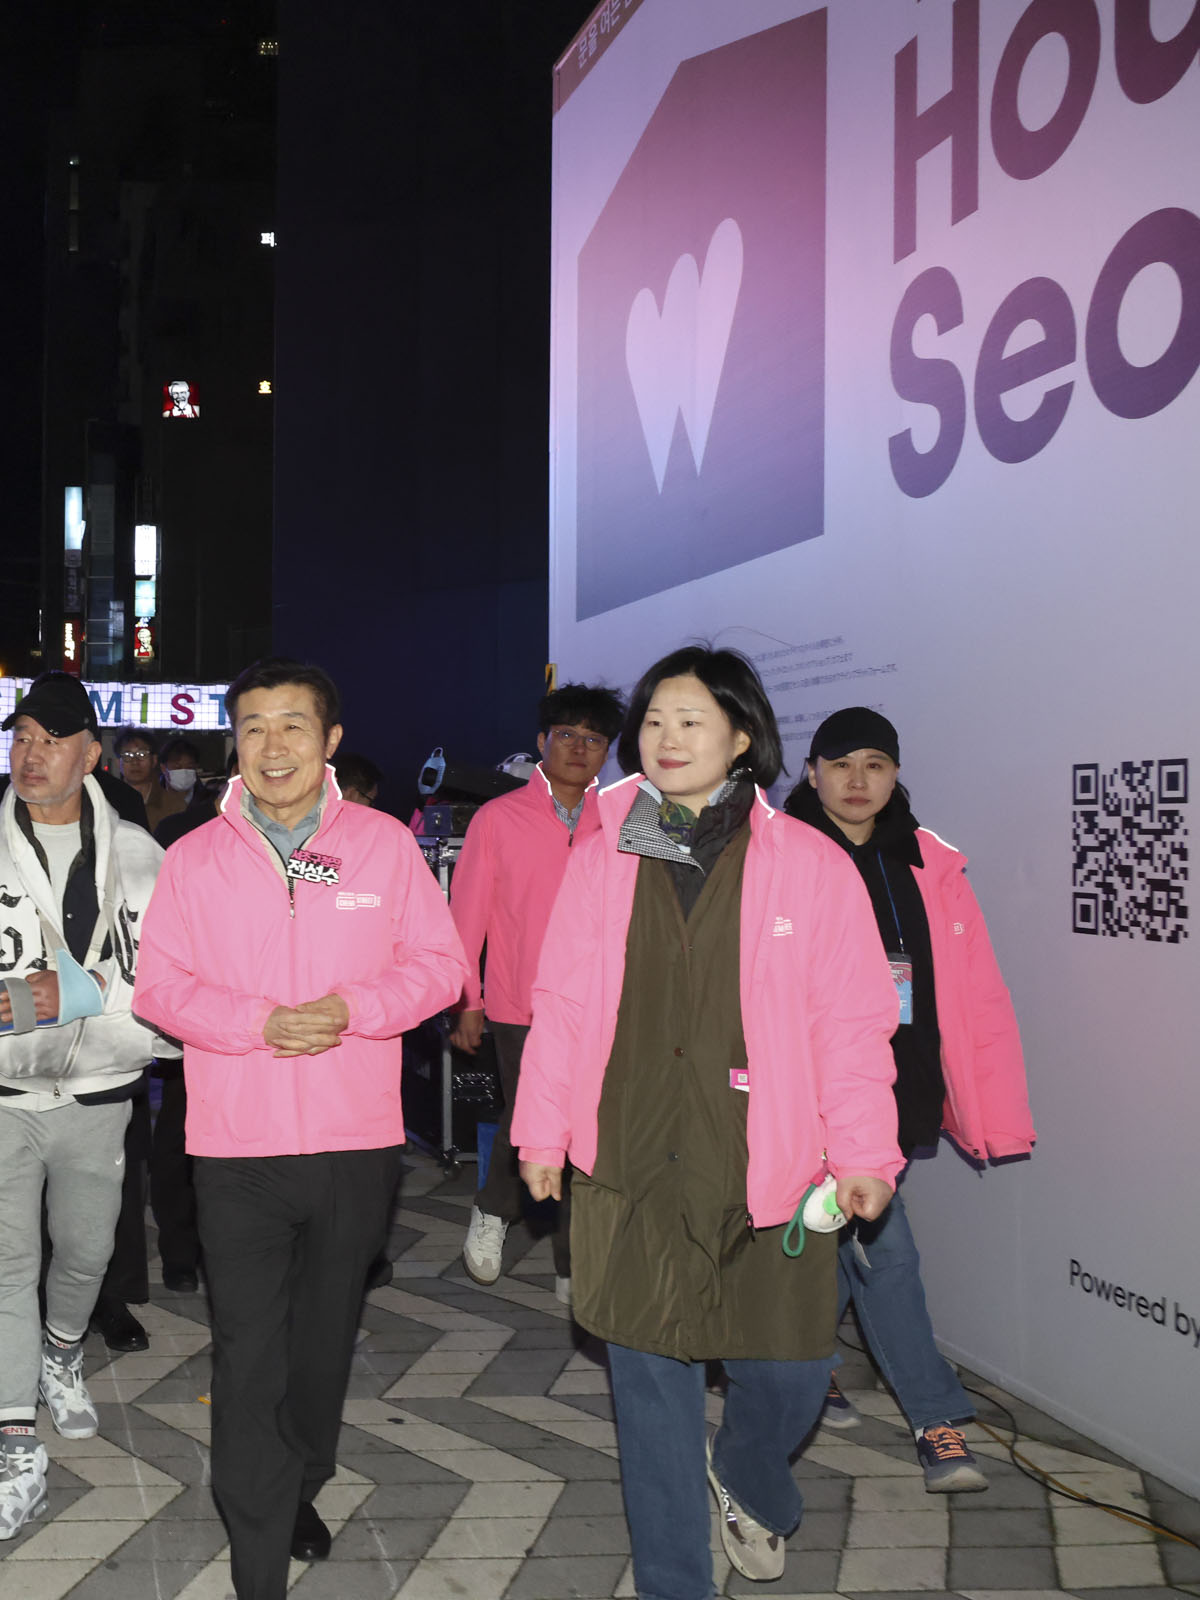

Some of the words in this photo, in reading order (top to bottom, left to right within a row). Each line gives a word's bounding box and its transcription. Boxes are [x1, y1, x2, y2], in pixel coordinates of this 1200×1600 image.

[286, 858, 340, 887] 전성수
[1069, 1258, 1167, 1327] Powered
[1174, 1301, 1200, 1349] by
